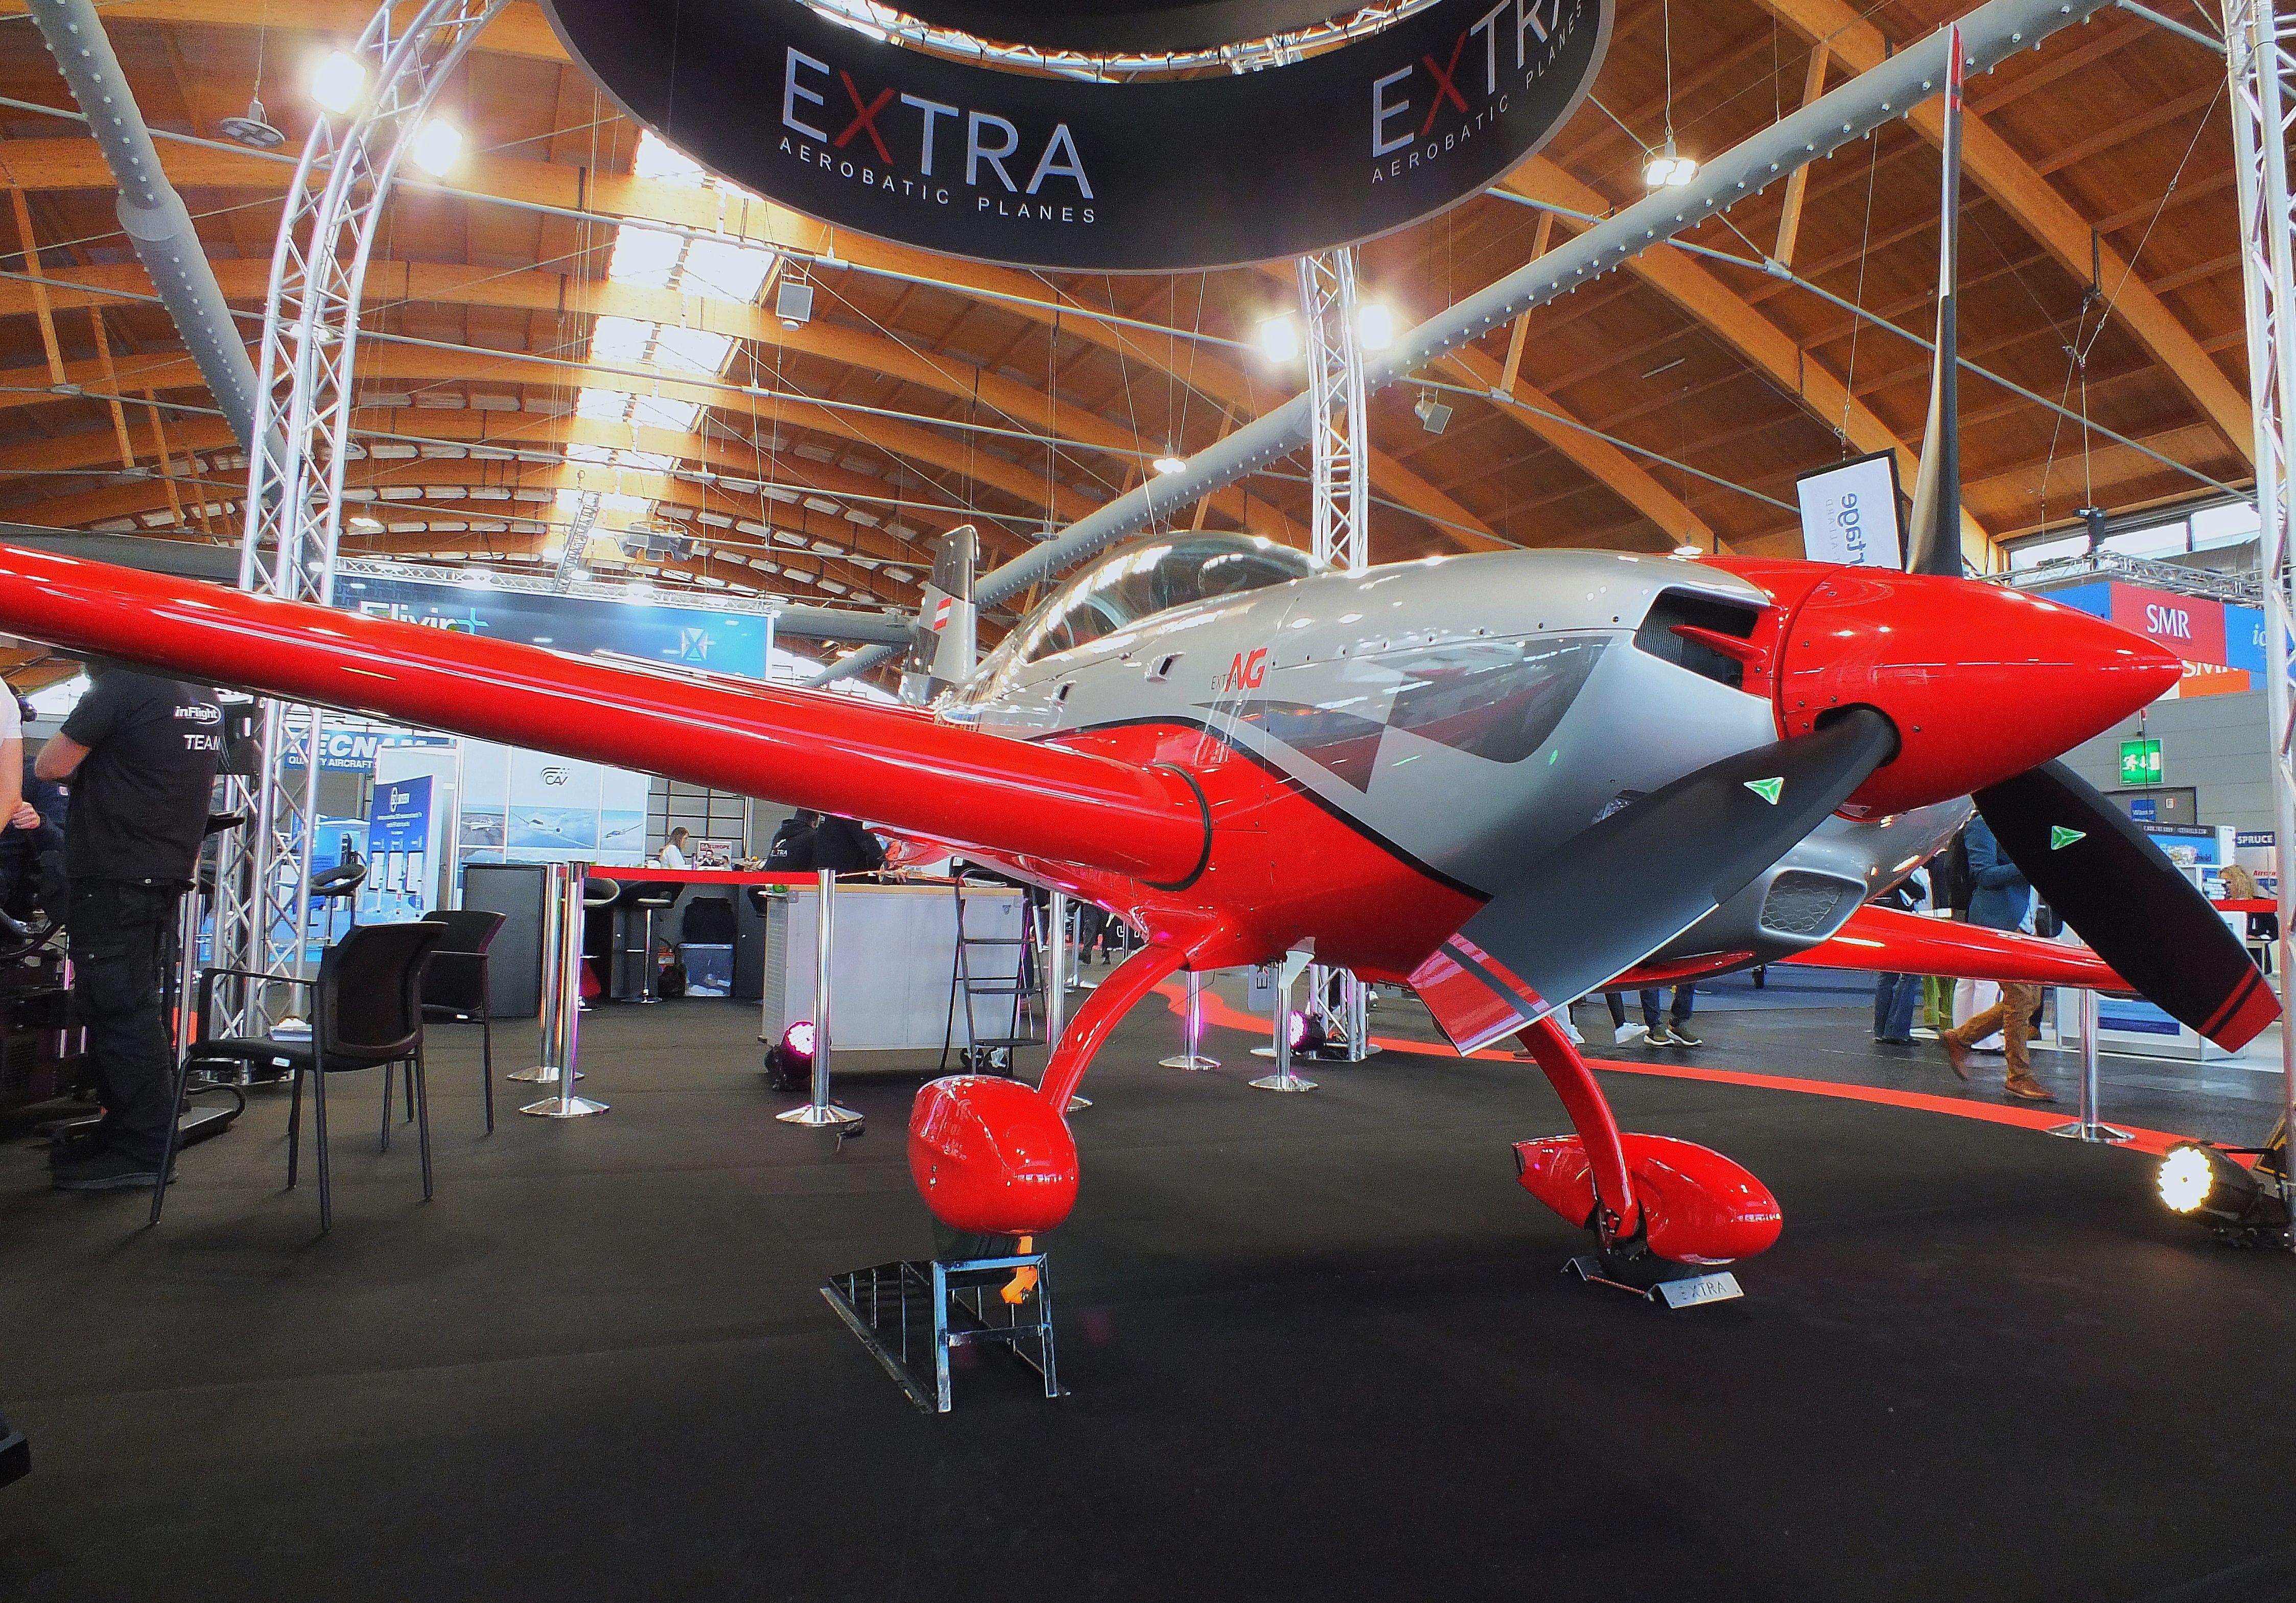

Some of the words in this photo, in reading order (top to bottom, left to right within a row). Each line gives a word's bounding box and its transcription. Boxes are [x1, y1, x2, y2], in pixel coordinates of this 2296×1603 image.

[1372, 95, 1508, 184] AEROBATIC
[1526, 0, 1582, 90] PLANES
[1373, 0, 1559, 157] EXTR
[783, 46, 1094, 199] EXTRA
[779, 137, 949, 204] AEROBATIC
[978, 196, 1096, 224] PLANES
[2146, 604, 2191, 639] SMR
[1225, 647, 1268, 692] NG
[328, 758, 372, 768] AIRCRAFT
[2237, 835, 2274, 844] SPRUCE
[1679, 1281, 1727, 1300] EXTRA
